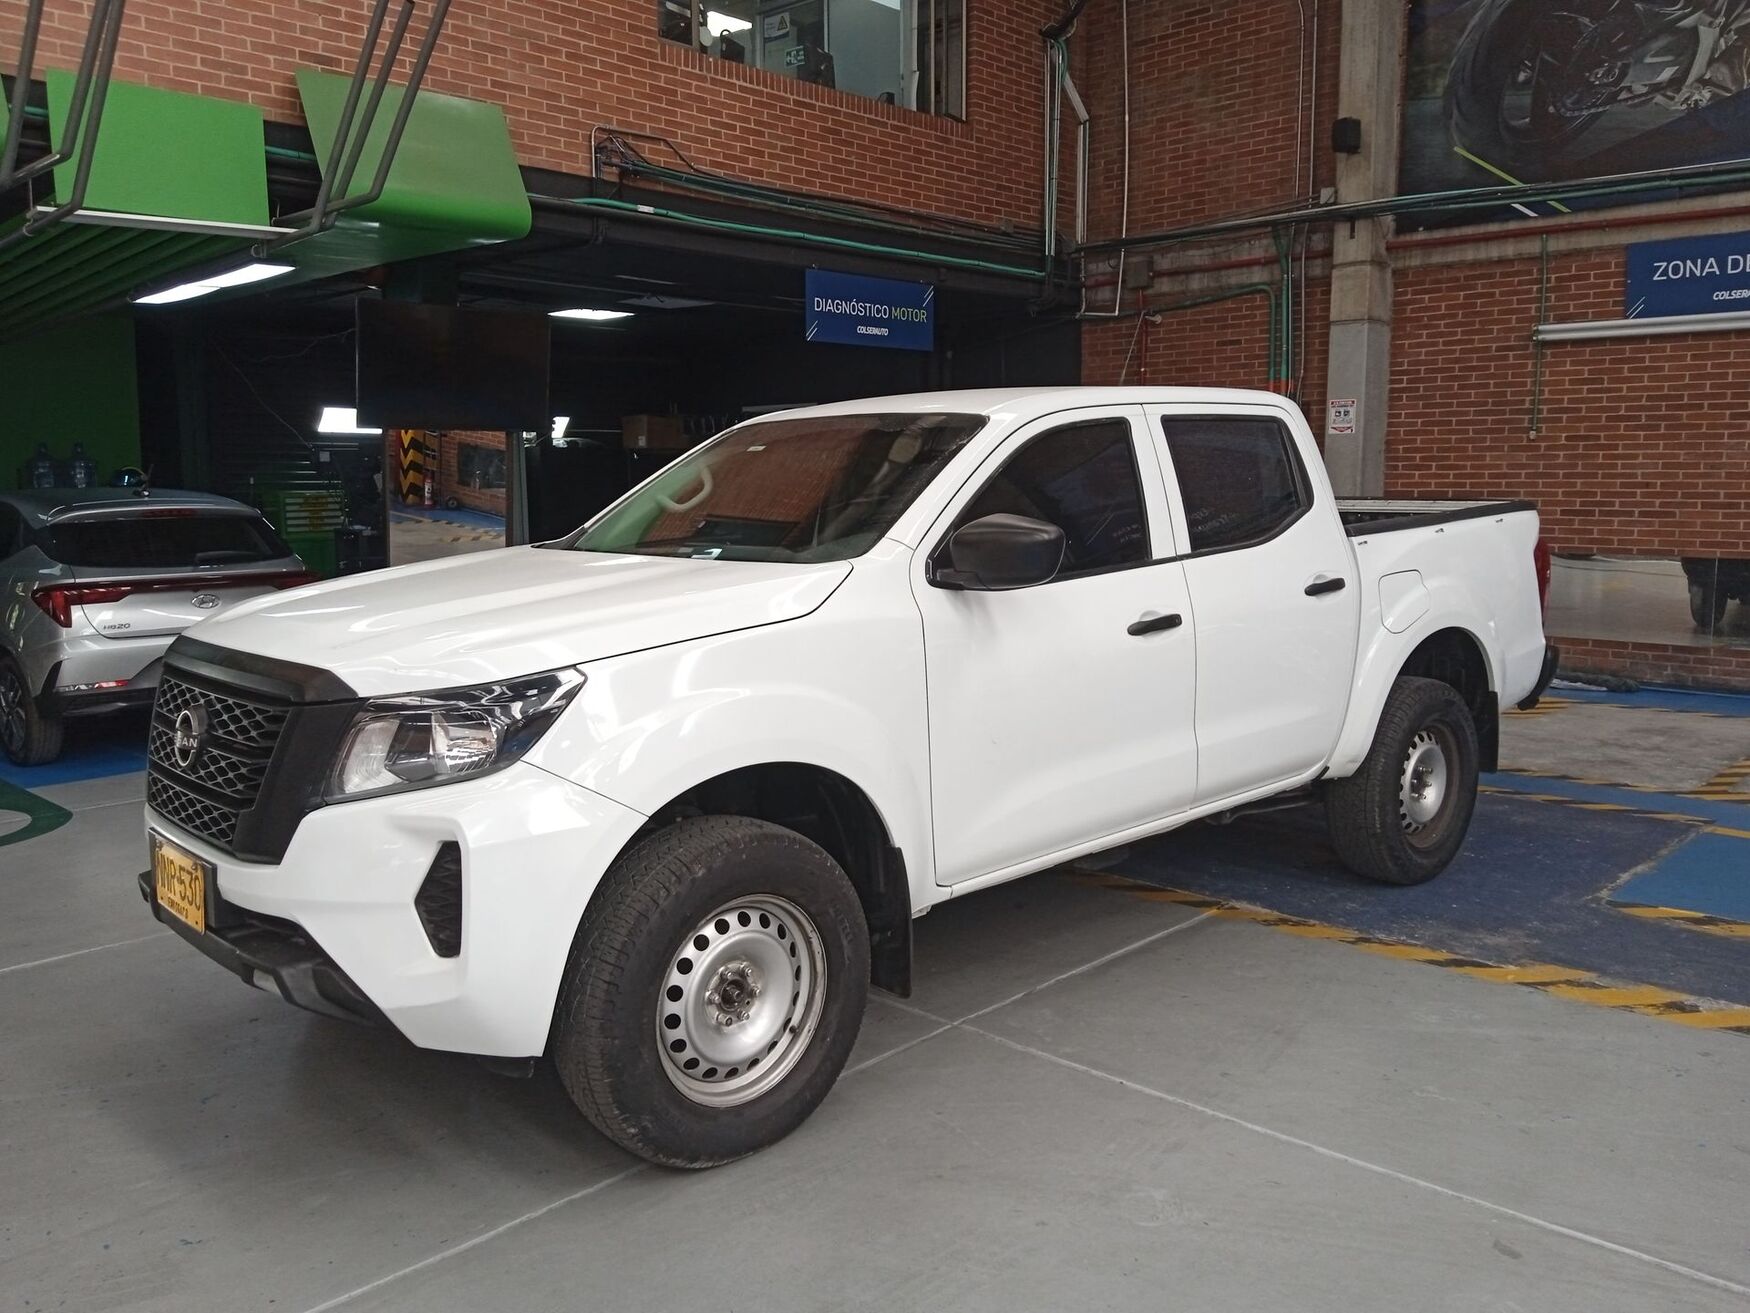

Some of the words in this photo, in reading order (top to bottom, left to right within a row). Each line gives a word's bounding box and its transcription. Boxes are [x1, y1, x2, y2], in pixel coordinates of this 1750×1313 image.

[1653, 257, 1720, 280] ZONA
[814, 297, 889, 319] DIAGNÓSTICO
[891, 306, 927, 323] MOTOR
